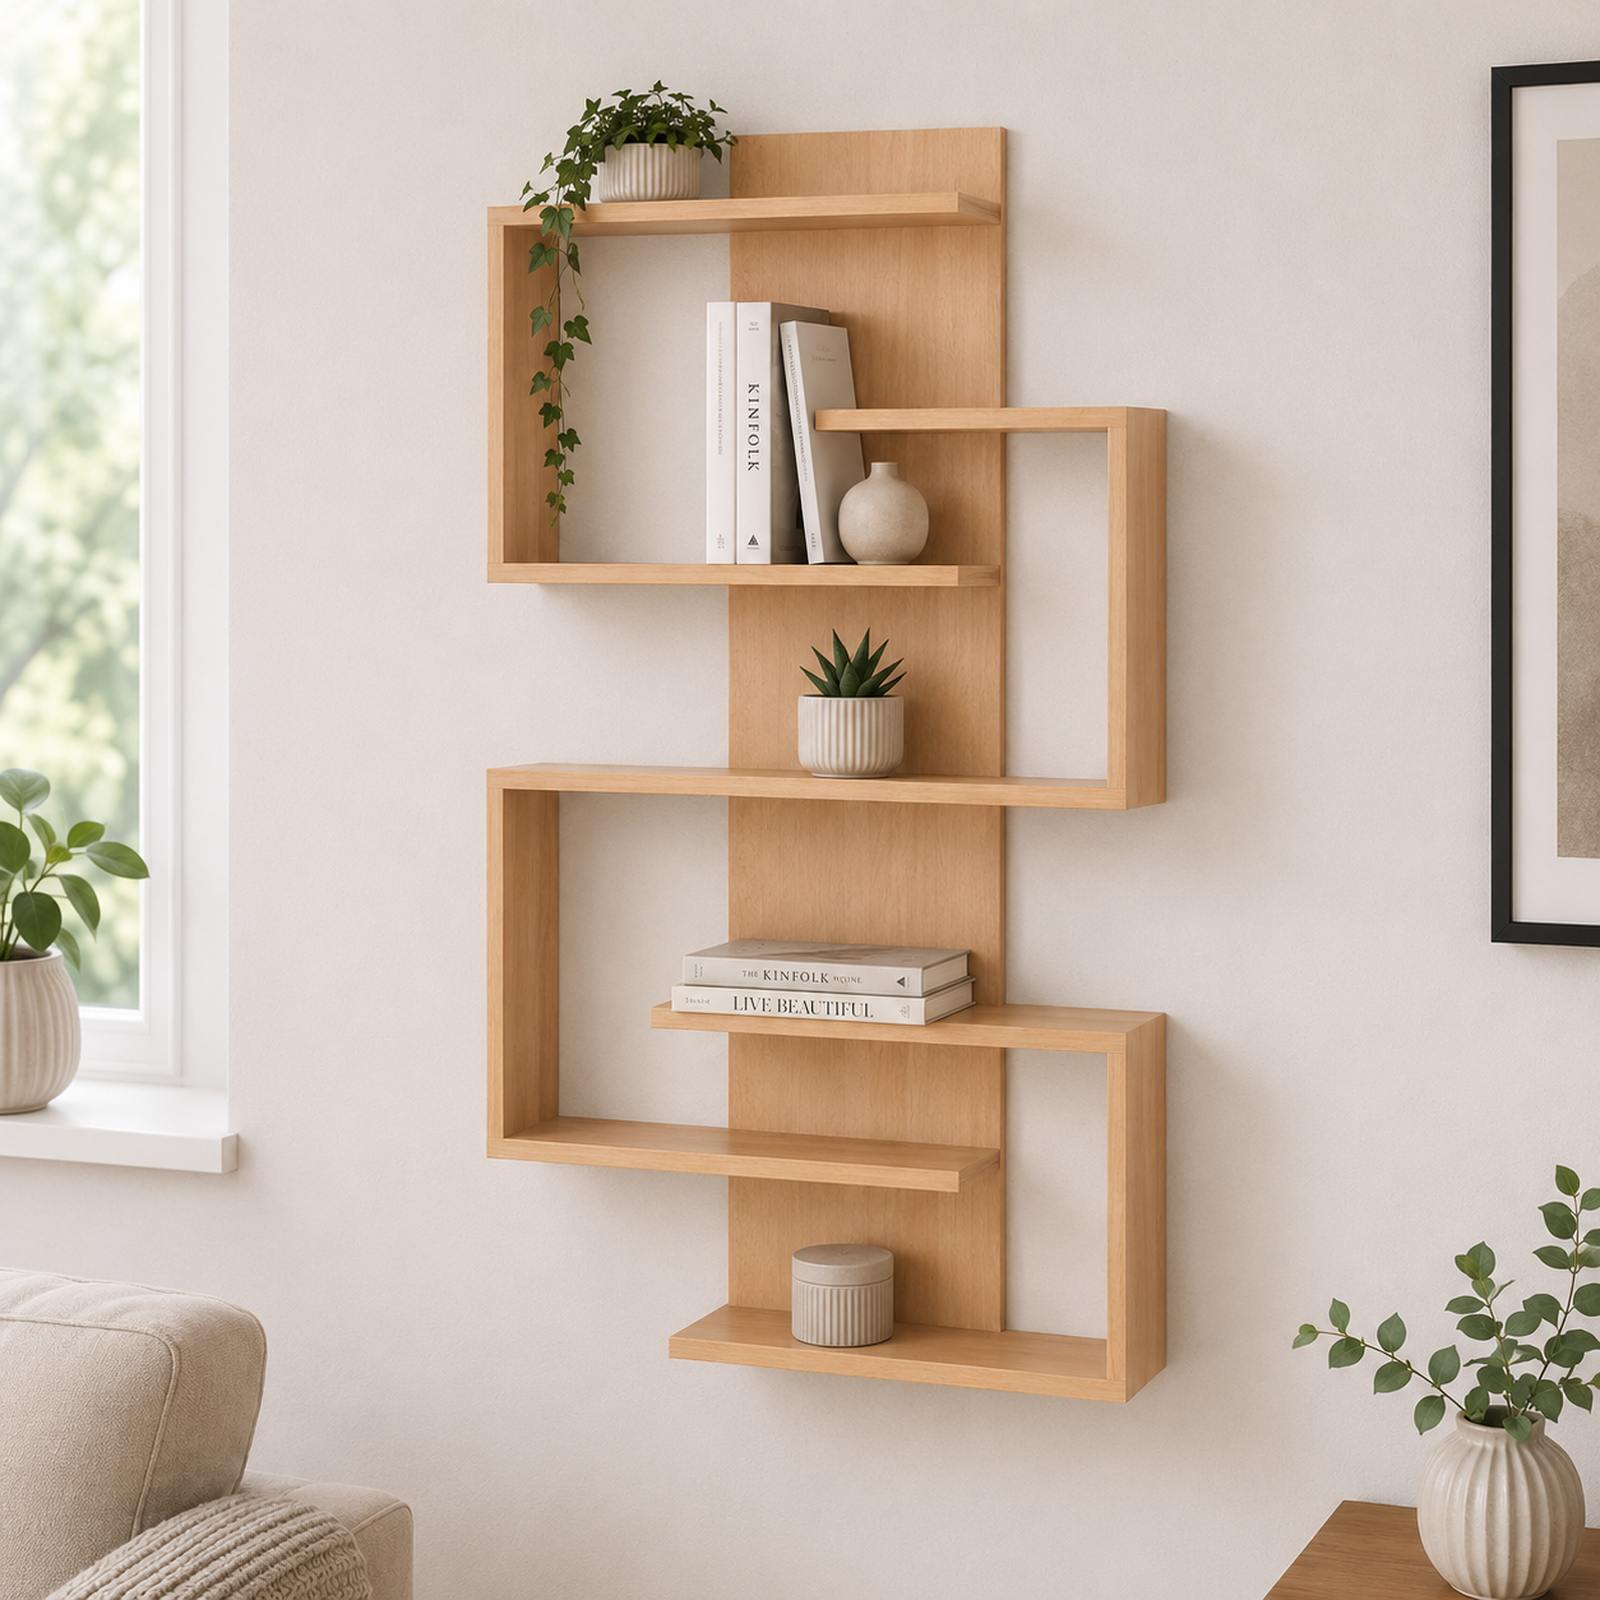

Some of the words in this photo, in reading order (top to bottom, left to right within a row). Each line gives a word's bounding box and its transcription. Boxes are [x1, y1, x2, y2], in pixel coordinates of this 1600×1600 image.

[748, 383, 760, 471] KINFOLK
[742, 970, 759, 978] THE
[763, 969, 829, 984] KINFOLK
[733, 995, 772, 1013] LIVE
[777, 998, 874, 1018] BEAUTIFUL
